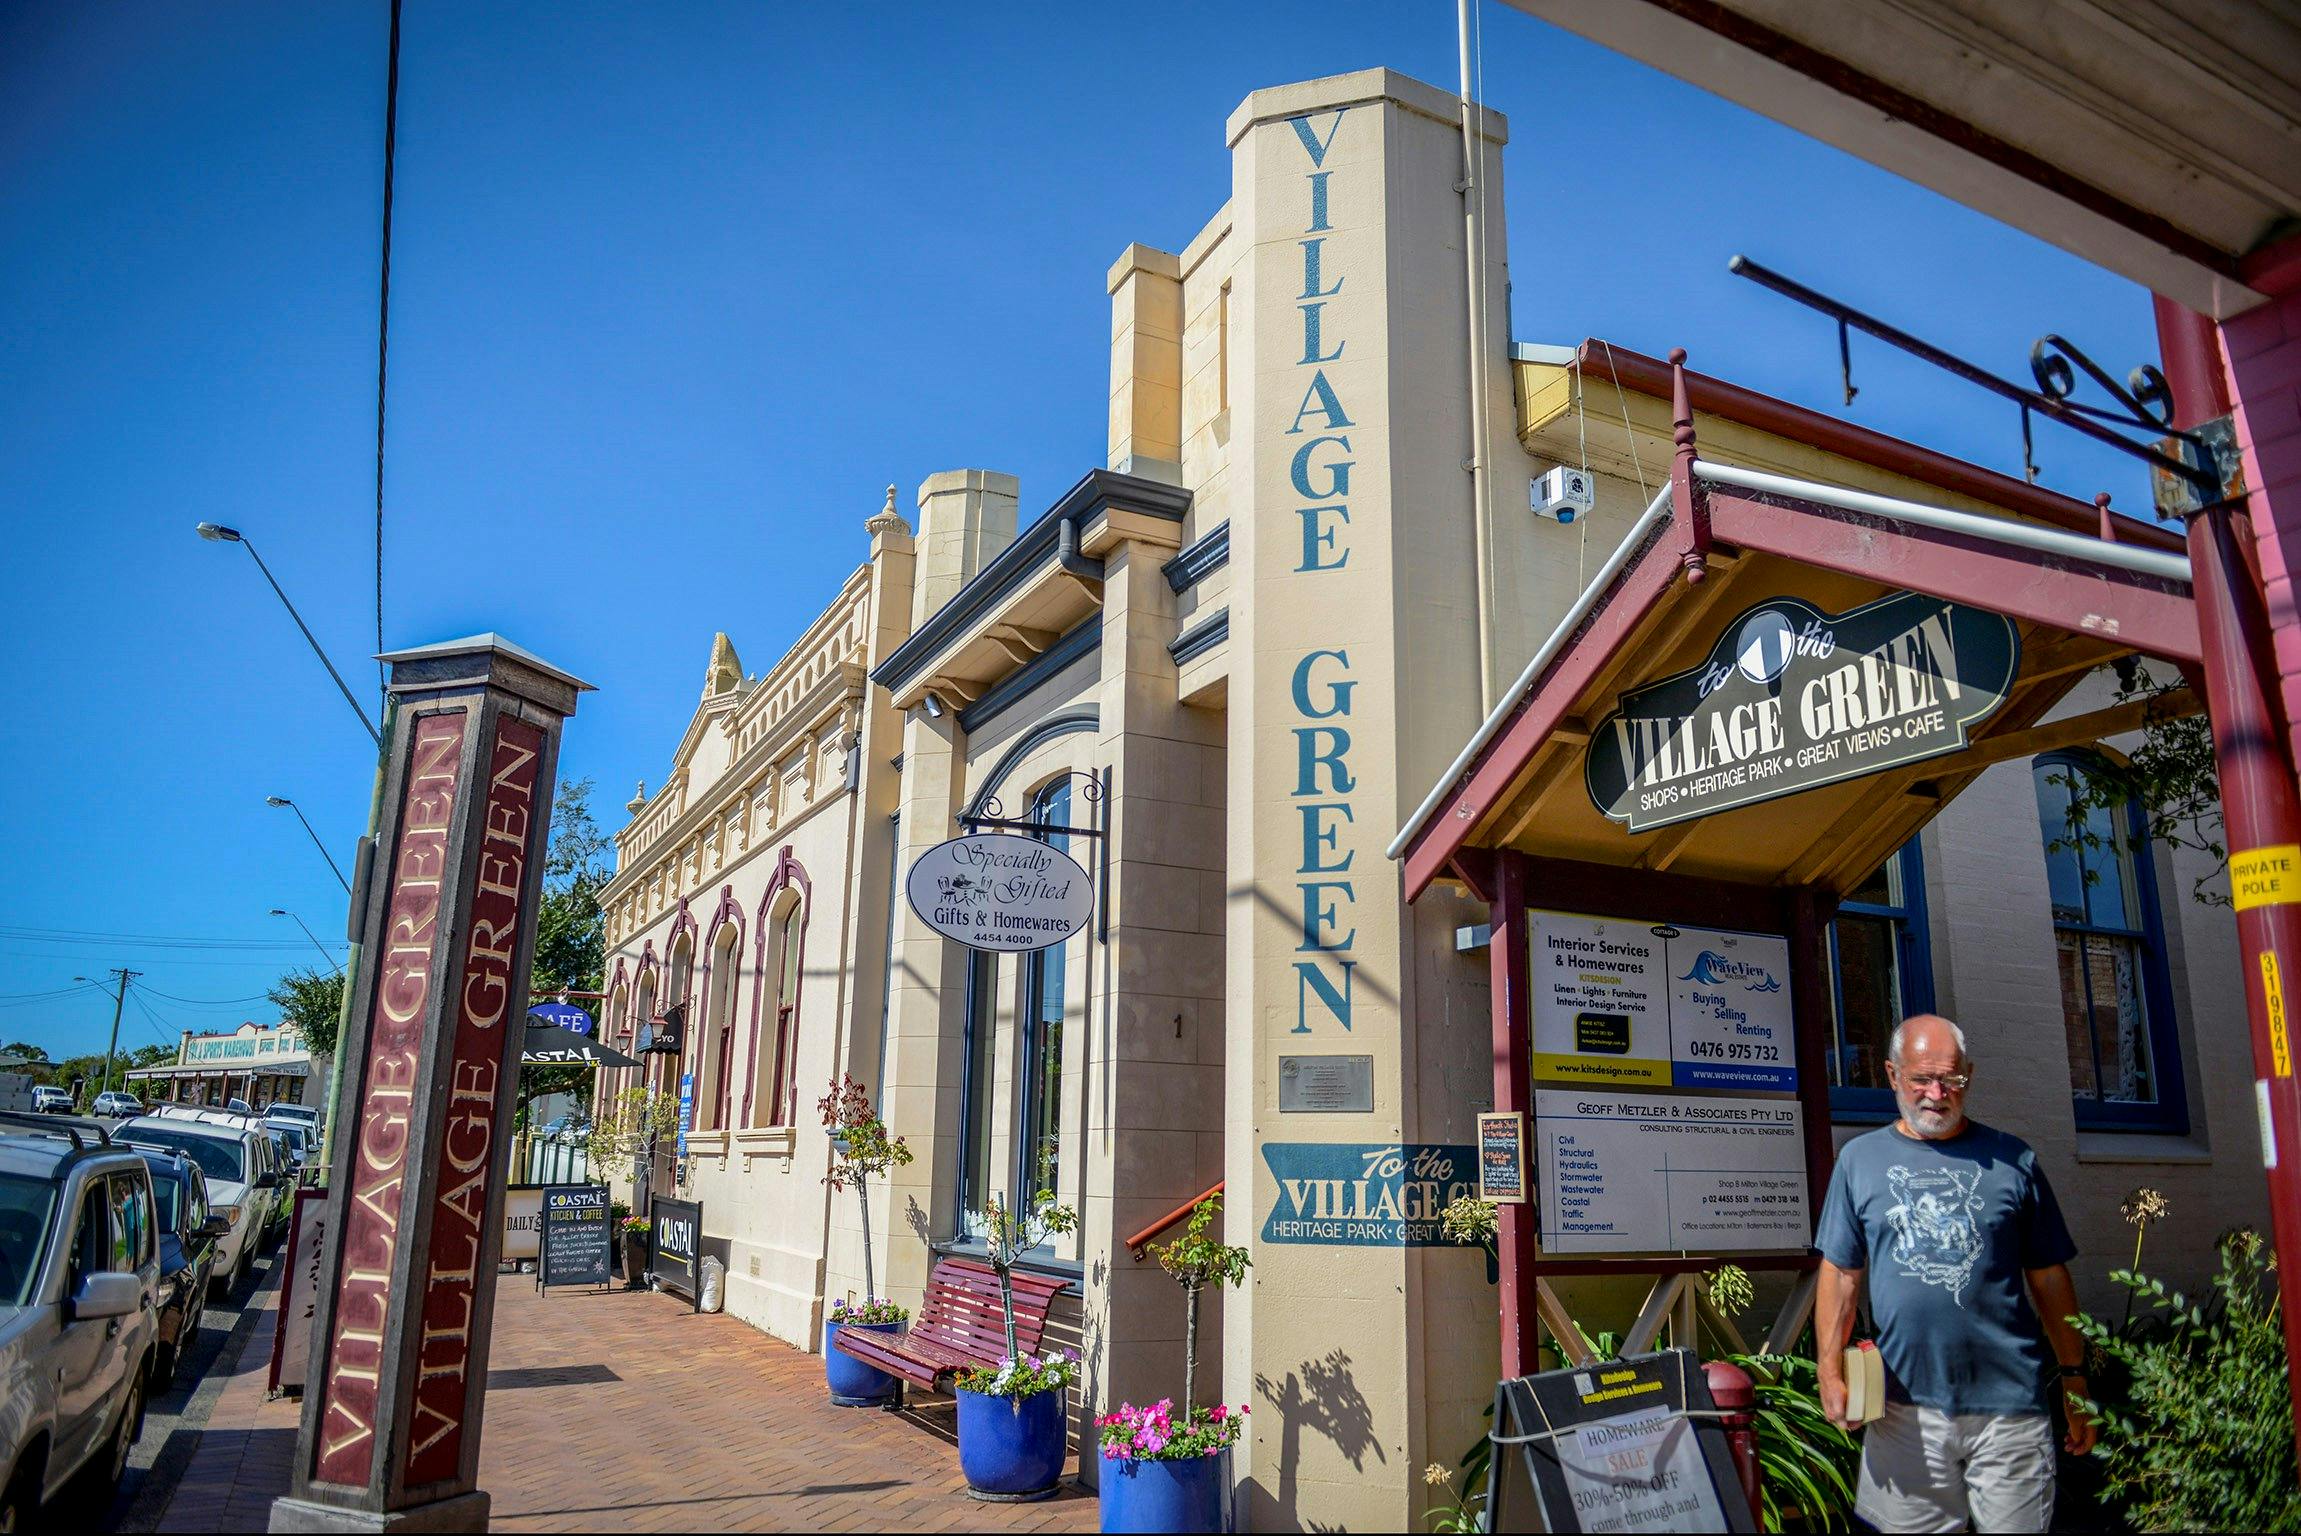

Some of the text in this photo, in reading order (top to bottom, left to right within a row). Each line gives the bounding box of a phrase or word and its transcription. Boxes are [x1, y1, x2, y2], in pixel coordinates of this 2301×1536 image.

[1284, 108, 1356, 573] VILLAGE
[1698, 621, 1836, 698] to the
[1614, 604, 1962, 790] VILLAGE GREEN
[1640, 711, 1945, 810] SHOPS HERITAGE PARK GREAT VIEWS CAFE
[1290, 649, 1358, 1034] GREEN
[952, 843, 1053, 877] Specially
[2234, 858, 2291, 879] PRIVATE
[994, 875, 1070, 905] Gifted
[2242, 879, 2281, 896] POLE
[934, 907, 1070, 932] Gifts & Homewares
[973, 933, 1033, 945] 4454 4000
[1547, 935, 1650, 958] Interior Services
[1555, 955, 1644, 974] & Homewares
[1707, 957, 1765, 977] WaveView
[1579, 973, 1622, 985] KITSDESIGN
[1554, 983, 1647, 1000] Linen Lights Furniture
[1693, 992, 1726, 1008] Buying
[1556, 996, 1646, 1012] Interior Design Service
[538, 1013, 583, 1032] AFÉ
[1714, 1008, 1746, 1023] Selling
[2262, 955, 2287, 1075] 319847
[1173, 1014, 1182, 1038] 1
[1736, 1024, 1772, 1039] Renting
[1691, 1041, 1779, 1061] 0476 975 732
[1555, 1064, 1652, 1077] www.kitsdesign.com.au
[1693, 1070, 1779, 1083] www.waveview.com.au
[322, 731, 460, 1464] VILLAGE GREEN
[410, 731, 536, 1468] VILLAGE GREEN
[1577, 1102, 1794, 1121] GEOFF METZLER & ASSOCIATES PTY LTD
[1639, 1124, 1683, 1133] CONSULTING
[1685, 1126, 1730, 1135] STRUCTURAL
[1758, 1128, 1795, 1136] ENGINEERS
[1558, 1136, 1575, 1145] Civil
[1559, 1148, 1594, 1157] Structural
[1412, 1147, 1453, 1181] the
[1559, 1160, 1598, 1170] Hydraulics
[1560, 1172, 1603, 1182] Stormwater
[1718, 1180, 1734, 1188] Shop
[1741, 1180, 1758, 1188] Milton
[1759, 1180, 1778, 1189] Village
[1561, 1185, 1604, 1194] Wastewater
[550, 1194, 604, 1207] COASTAL
[1282, 1179, 1441, 1221] VILLAGE
[1561, 1197, 1590, 1206] Coastal
[550, 1208, 603, 1220] KITCHEN & COFFEE
[1562, 1209, 1584, 1218] Traffic
[506, 1216, 535, 1231] DAILY
[1273, 1220, 1342, 1238] HERITAGE
[1347, 1222, 1388, 1240] PARK
[1396, 1223, 1434, 1241] GREAT
[1562, 1222, 1613, 1232] Management
[659, 1217, 694, 1256] COASTAL
[1608, 1449, 1648, 1473] SALE
[1650, 1471, 1680, 1491] OFF
[1624, 1501, 1675, 1526] through
[1677, 1493, 1700, 1514] and
